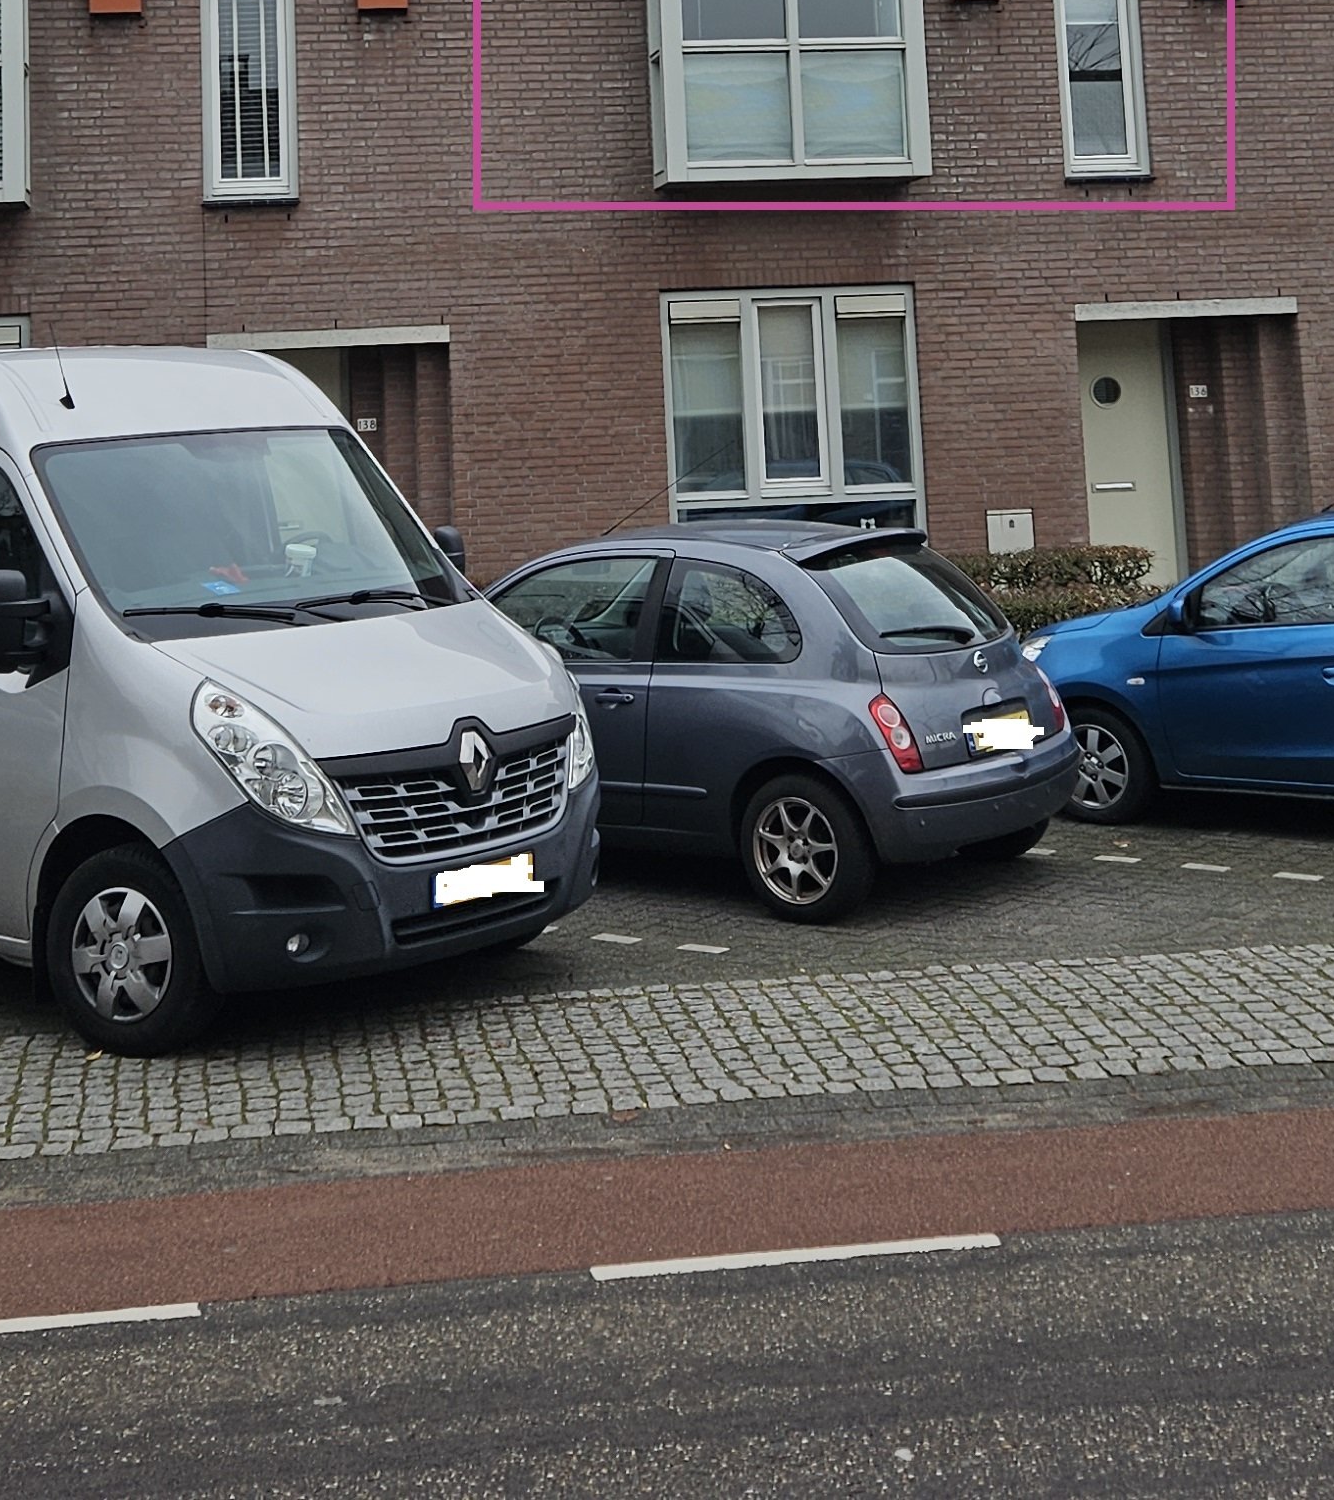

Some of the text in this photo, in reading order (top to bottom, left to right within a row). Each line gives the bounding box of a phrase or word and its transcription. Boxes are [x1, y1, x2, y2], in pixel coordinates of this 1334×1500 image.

[1190, 386, 1207, 397] 136
[358, 419, 376, 430] 138
[925, 731, 957, 745] MICRA
